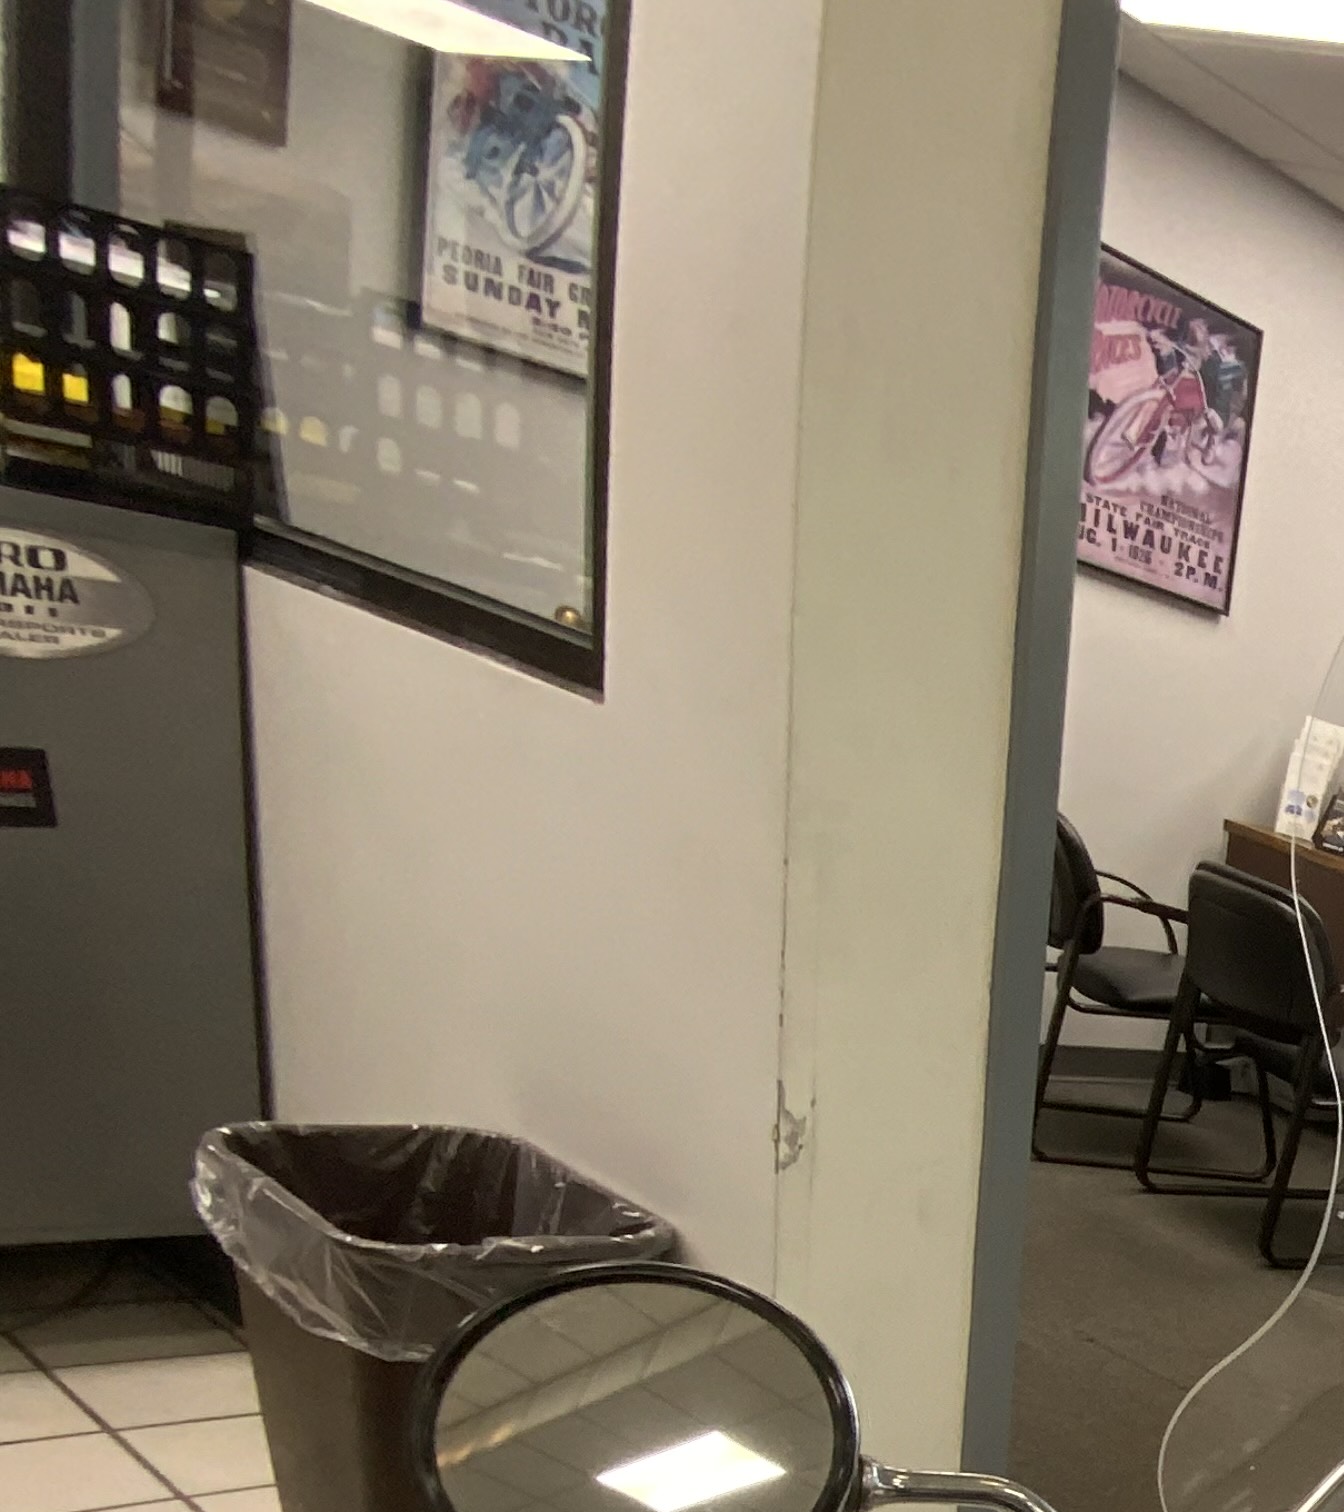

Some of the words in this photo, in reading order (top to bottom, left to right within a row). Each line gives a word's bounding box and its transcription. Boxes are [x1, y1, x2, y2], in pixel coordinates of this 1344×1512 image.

[442, 264, 561, 318] SUNDAY
[517, 264, 555, 295] FAIR
[1086, 492, 1127, 517] STATE
[1136, 511, 1165, 531] FAIR
